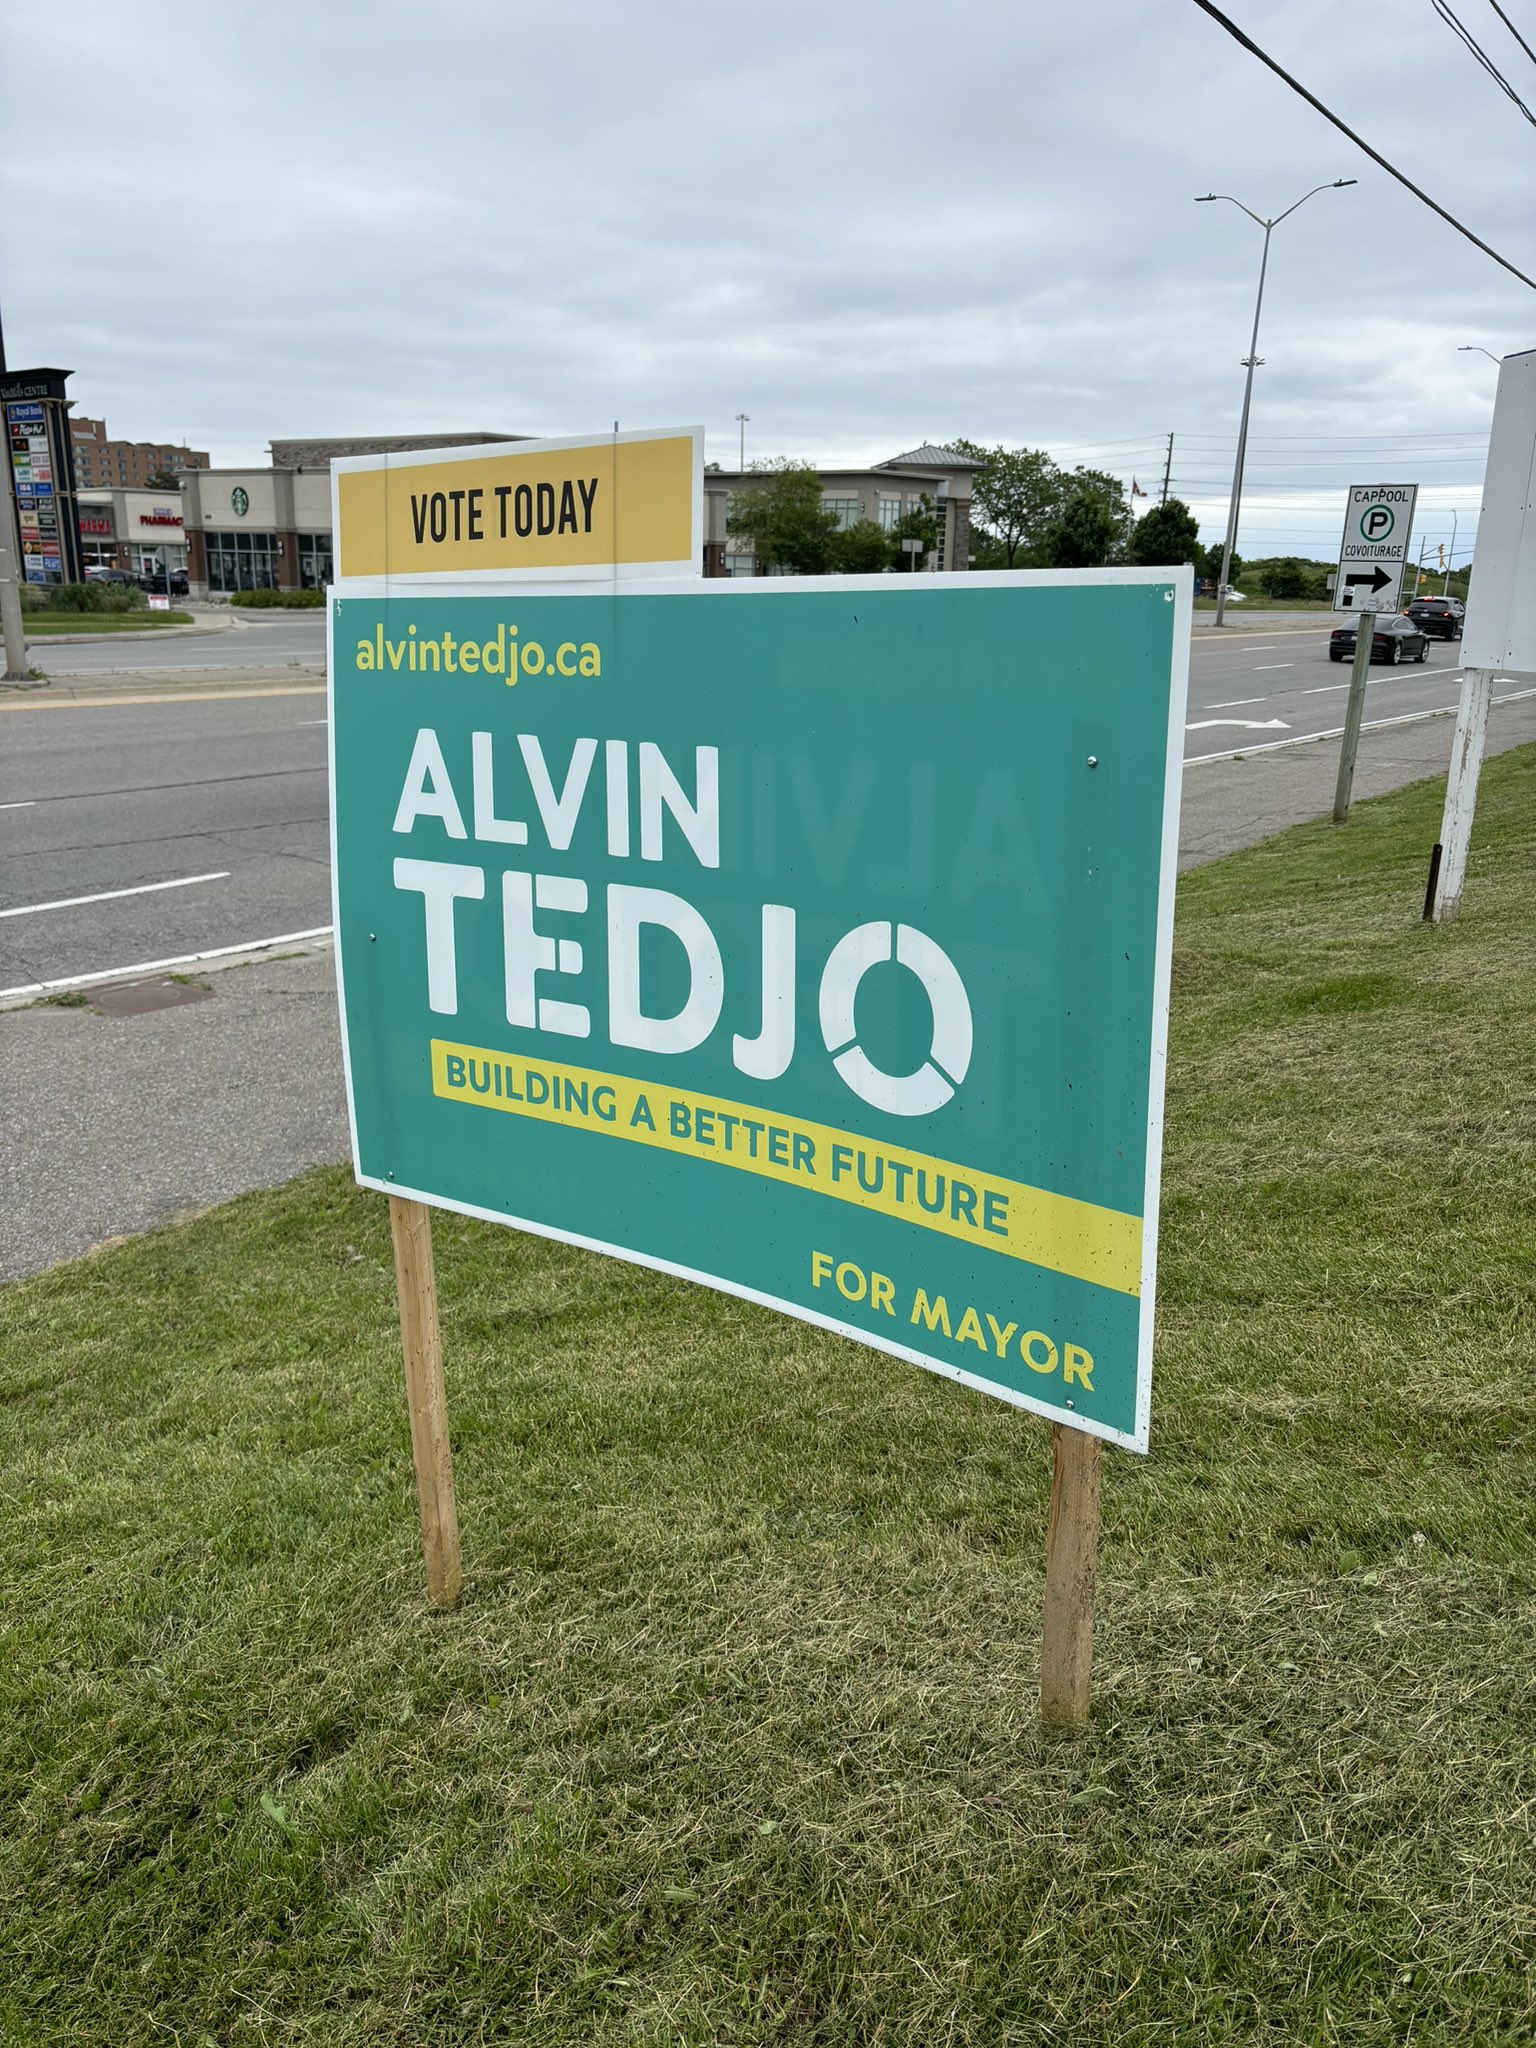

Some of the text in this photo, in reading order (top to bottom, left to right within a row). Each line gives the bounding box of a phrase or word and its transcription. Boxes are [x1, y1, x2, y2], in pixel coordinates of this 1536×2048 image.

[410, 477, 599, 544] VOTE TODAY
[1345, 545, 1402, 558] COVOITURAGE
[1368, 511, 1388, 536] P
[355, 624, 601, 686] alvintedjo.ca
[392, 728, 721, 869] ALVIN
[392, 857, 975, 1117] TEDJO
[445, 1054, 1009, 1239] BUILDING A BETTER FUTURE
[811, 1252, 1094, 1391] FOR MAYOR
